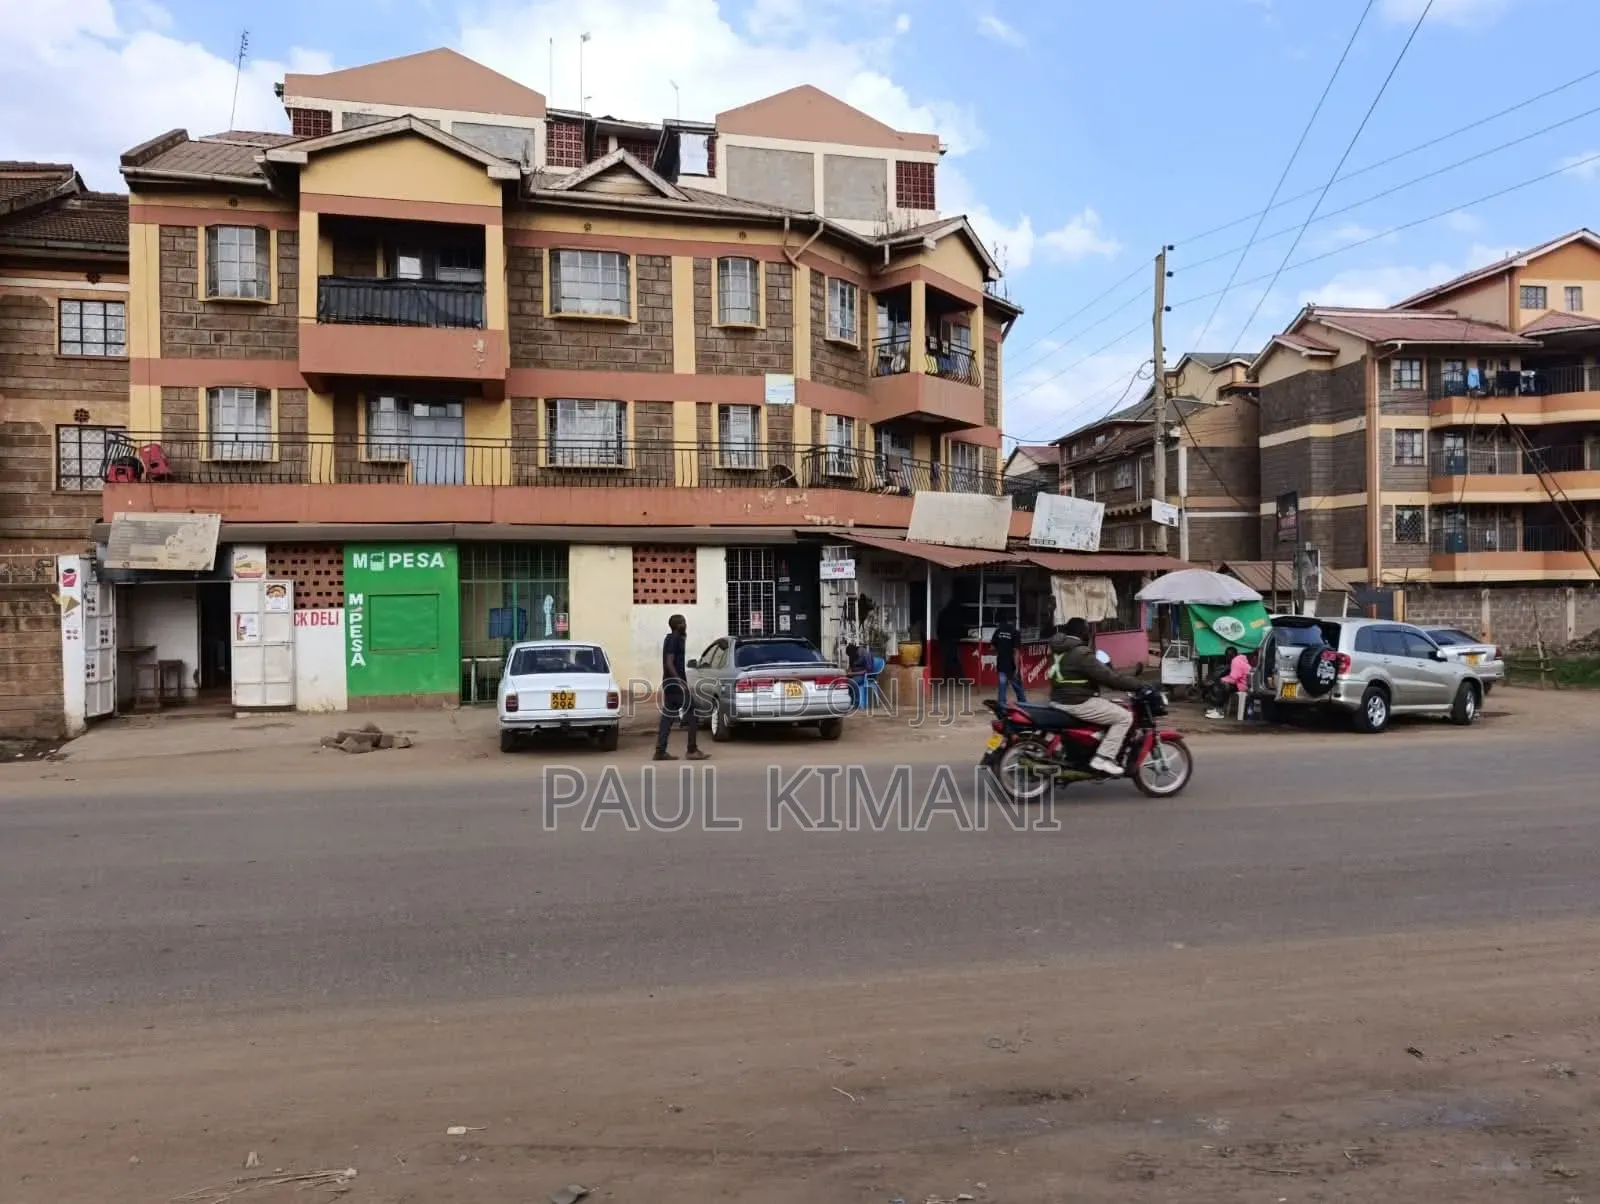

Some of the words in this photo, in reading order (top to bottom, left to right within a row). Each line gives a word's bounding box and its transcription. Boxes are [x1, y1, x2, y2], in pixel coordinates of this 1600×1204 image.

[353, 553, 367, 568] M
[388, 552, 445, 568] PESA
[311, 611, 339, 626] DELI
[349, 613, 366, 667] PESA
